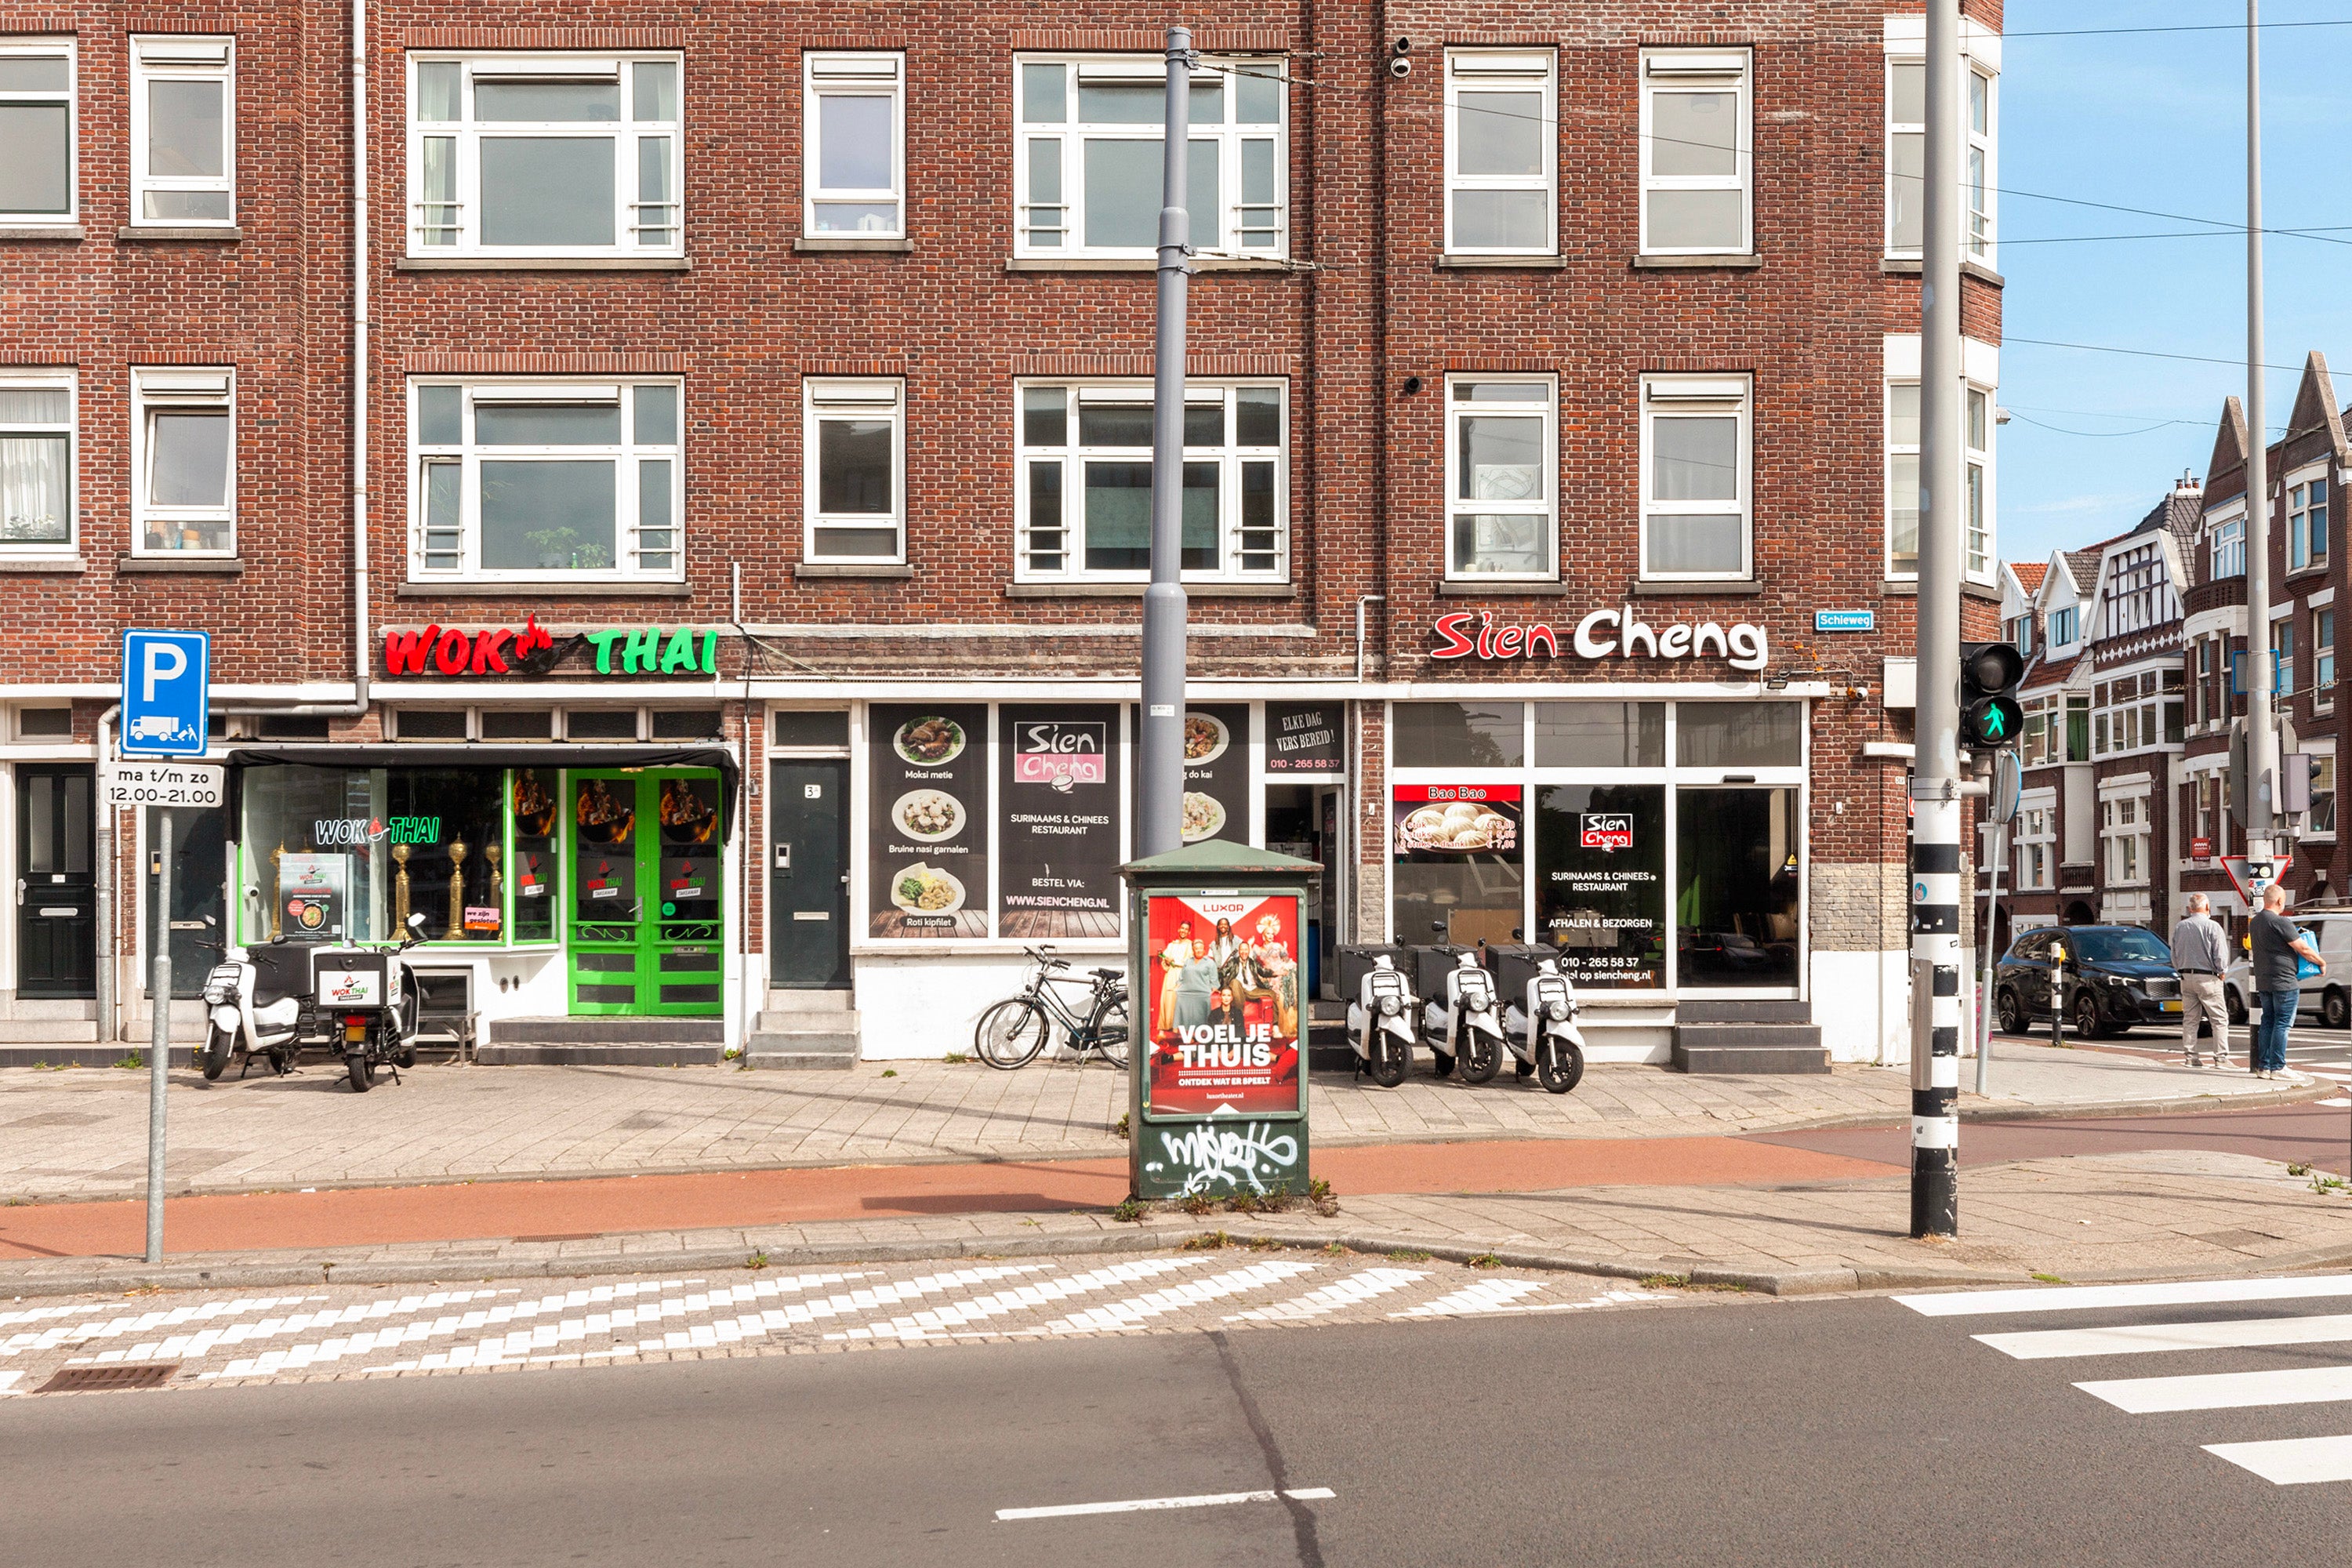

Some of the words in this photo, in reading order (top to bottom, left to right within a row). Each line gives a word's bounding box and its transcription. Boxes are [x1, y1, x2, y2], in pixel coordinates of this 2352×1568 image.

[1820, 615, 1870, 627] Schieweg
[1430, 611, 1559, 659] Sien
[1573, 604, 1769, 671] Cheng
[385, 623, 514, 676] WOK
[587, 627, 718, 675] THAI
[143, 642, 187, 702] P
[1282, 714, 1305, 731] ELKE
[1305, 712, 1322, 728] DAG
[1025, 724, 1095, 753] Sien
[1276, 735, 1299, 752] VERS
[1299, 729, 1330, 749] BEREID
[1023, 754, 1098, 782] Cheng
[1270, 759, 1287, 768] 010
[1294, 759, 1313, 768] 265
[1314, 759, 1327, 768] 58
[1328, 759, 1340, 768] 37
[118, 771, 143, 782] ma
[150, 768, 183, 783] t/m
[190, 773, 209, 784] zo
[905, 770, 929, 779] Moksi
[930, 771, 953, 779] metie
[1189, 769, 1200, 779] do
[1200, 769, 1213, 779] kai
[110, 787, 216, 804] 12.00-21.00
[1428, 786, 1456, 799] Bao
[1459, 786, 1486, 799] Bao
[1010, 814, 1062, 824] SURINAAMS
[1063, 815, 1070, 824] &
[1072, 815, 1109, 825] CHINEES
[1587, 815, 1627, 832] Sien
[315, 818, 367, 845] WOK
[390, 816, 440, 844] THAI
[1032, 825, 1088, 835] RESTAURANT
[1400, 830, 1406, 839] 2
[1408, 830, 1432, 839] stuks
[1486, 830, 1493, 839] €
[1400, 840, 1406, 848] 2
[1408, 840, 1432, 848] stuks
[1440, 840, 1466, 848] drank
[1486, 840, 1493, 848] €
[1585, 832, 1628, 847] Cheng
[888, 844, 915, 854] Bruine
[916, 845, 932, 854] nasi
[934, 845, 969, 855] garnalen
[1552, 872, 1602, 881] SURINAAMS
[1603, 872, 1610, 881] &
[1612, 872, 1650, 881] CHINEES
[1032, 878, 1065, 887] BESTEL
[1067, 879, 1085, 888] VIA:
[1573, 883, 1628, 891] RESTAURANT
[1006, 895, 1110, 909] WWW.SIENCHENG.NL
[1203, 903, 1244, 913] LUXOR
[924, 917, 952, 927] kipfilet
[1548, 918, 1592, 928] AFHALEN
[1593, 919, 1601, 928] &
[1602, 919, 1653, 928] BEZORGEN
[1561, 957, 1580, 967] 010
[1588, 957, 1609, 967] 265
[1610, 957, 1624, 967] 58
[1626, 957, 1639, 967] 37
[1580, 971, 1592, 982] op
[1594, 970, 1652, 982] siencheng.nl
[1178, 1024, 1242, 1044] VOEL
[1245, 1023, 1272, 1043] JE
[1178, 1044, 1272, 1068] THUIS
[1178, 1078, 1212, 1087] ONTDEK
[1212, 1077, 1231, 1086] WAT
[1231, 1077, 1242, 1086] ER
[1242, 1076, 1272, 1085] SPEELT
